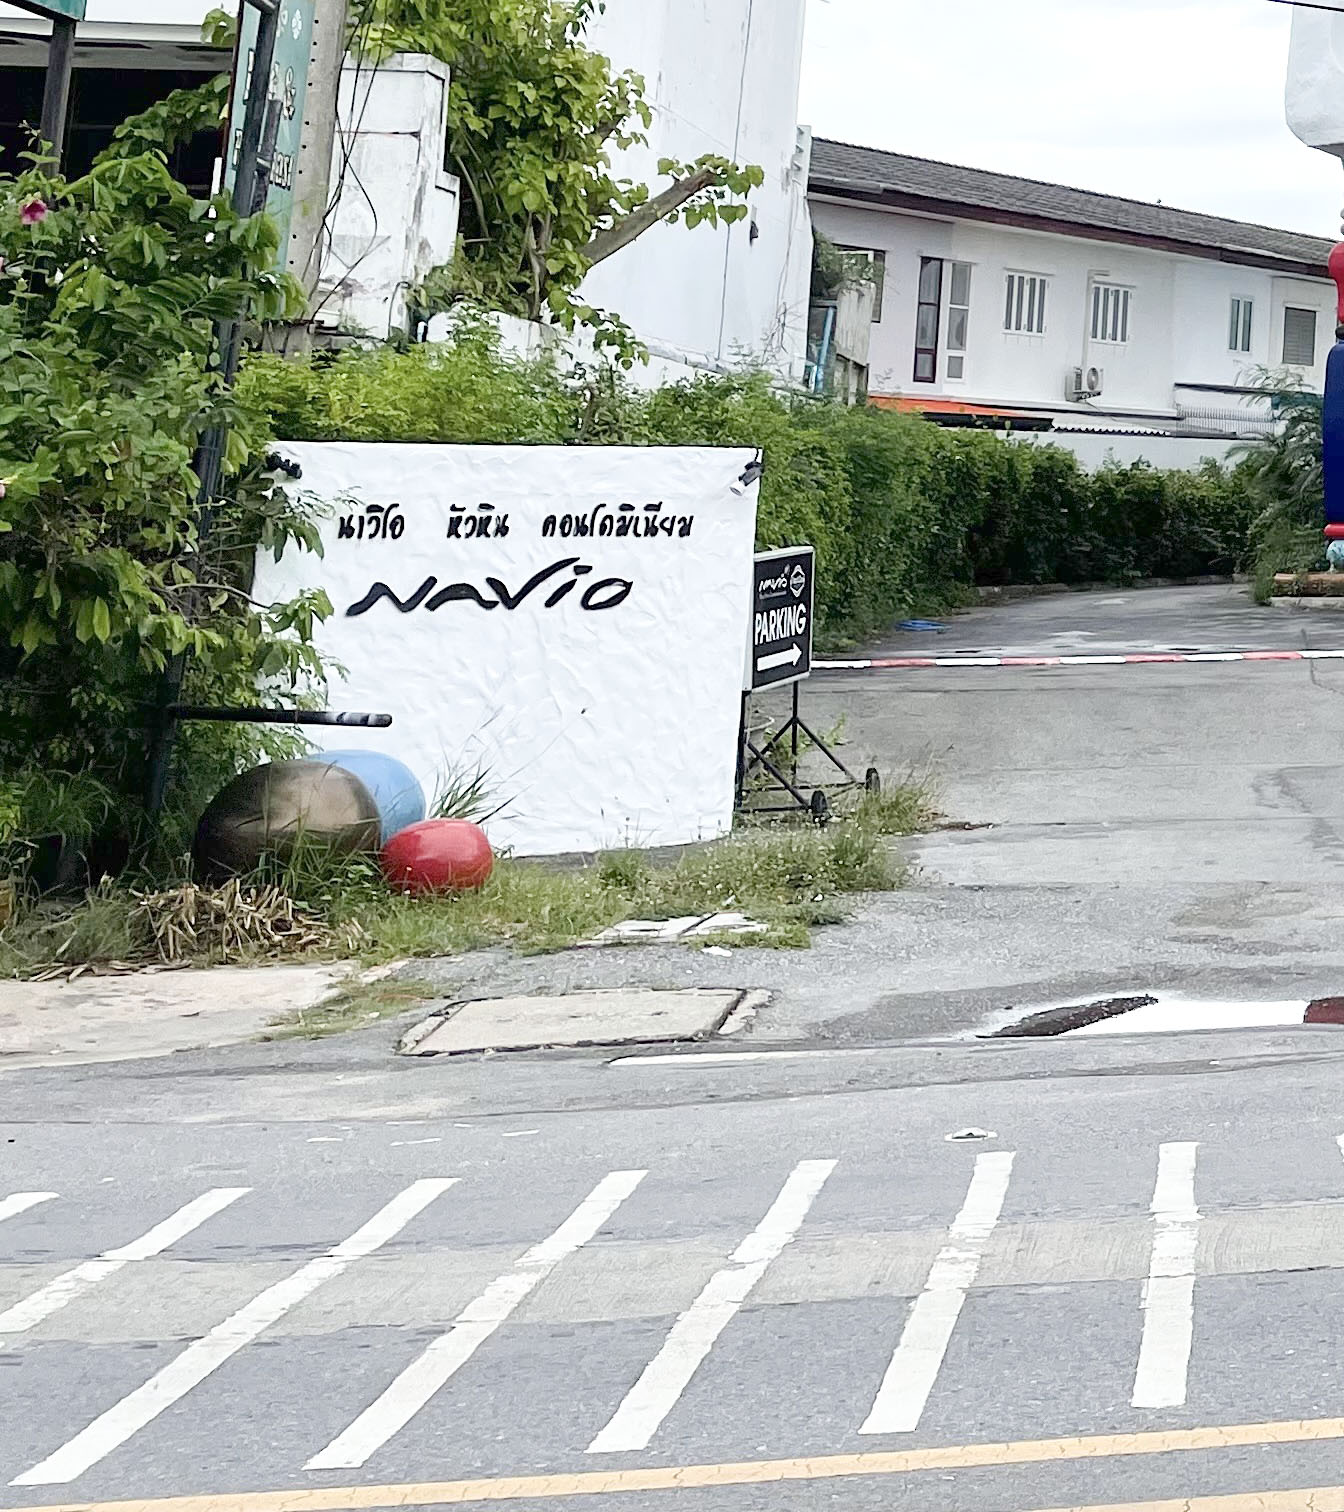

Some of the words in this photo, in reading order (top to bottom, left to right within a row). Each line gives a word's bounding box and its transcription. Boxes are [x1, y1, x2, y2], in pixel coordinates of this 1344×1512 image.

[338, 503, 405, 539] นาวิโอ
[447, 503, 510, 539] หัวหิน
[542, 501, 694, 539] คอนโดมิเนียม
[754, 603, 807, 646] PARKING
